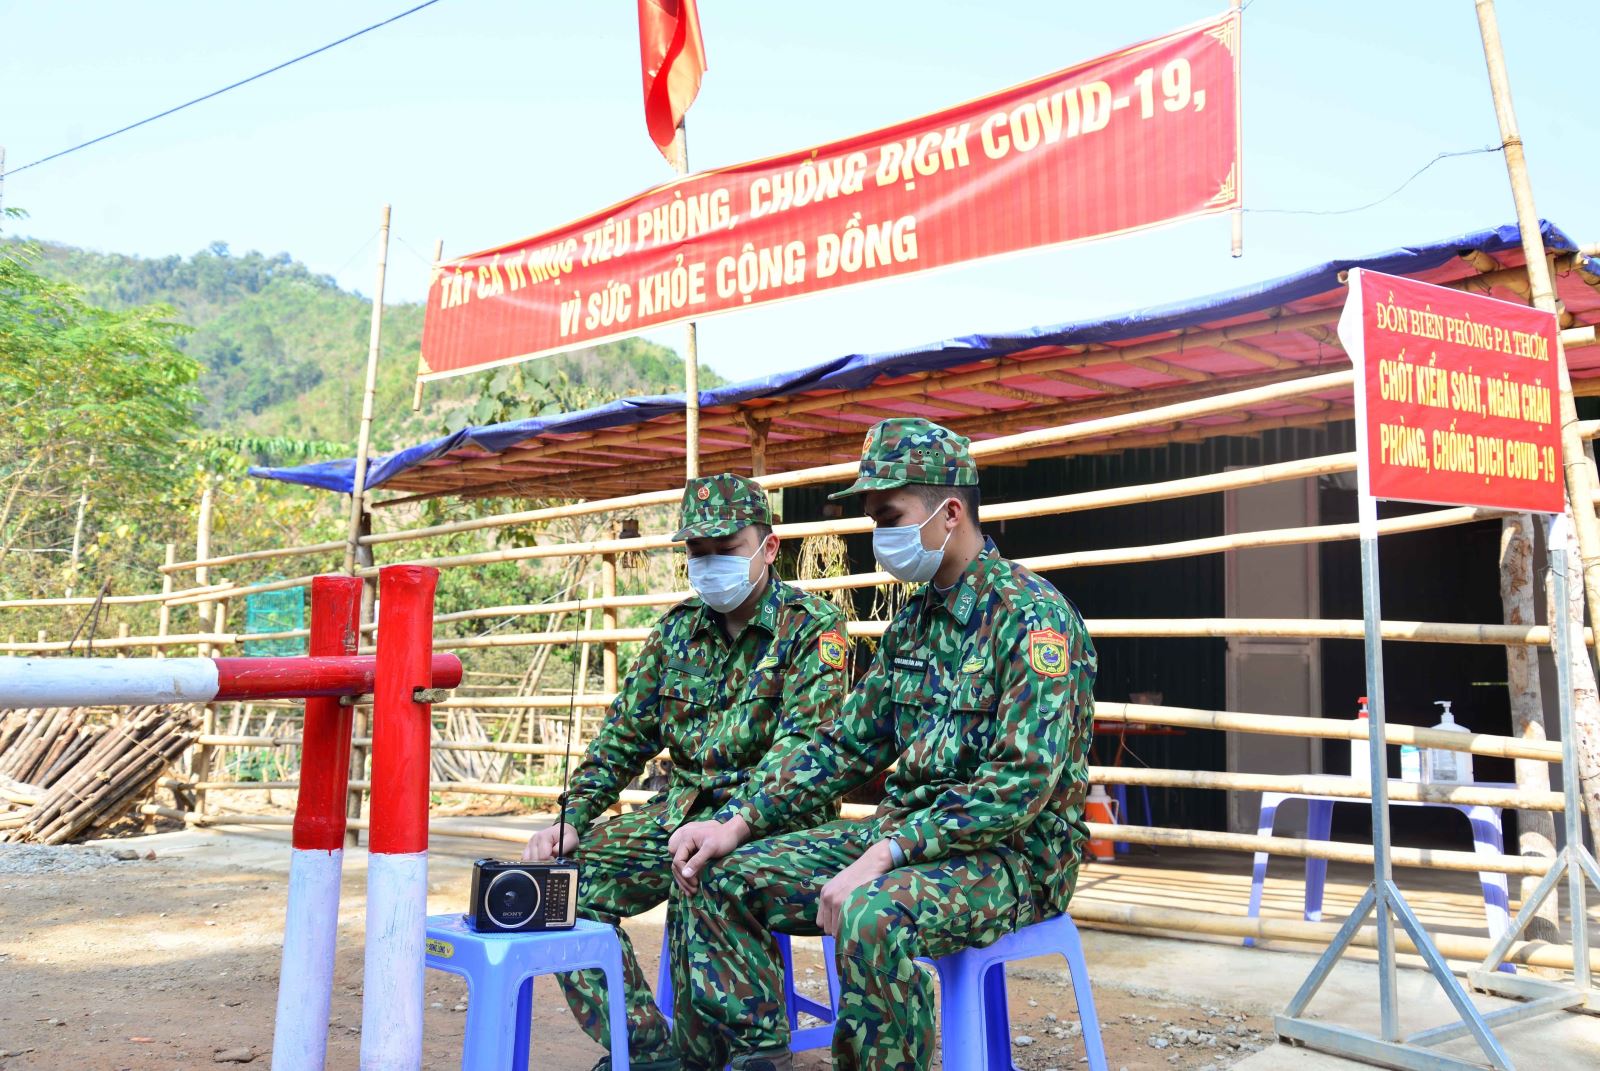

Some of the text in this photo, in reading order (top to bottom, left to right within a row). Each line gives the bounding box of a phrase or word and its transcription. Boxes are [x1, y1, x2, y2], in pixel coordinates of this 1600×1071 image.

[441, 262, 474, 310] TẤT
[504, 248, 527, 292] VÌ
[528, 238, 577, 286] MỤC
[581, 217, 631, 267] TIÊU
[635, 190, 739, 252] PHÒNG,
[750, 150, 868, 218] CHỐNG
[876, 123, 971, 192] DỊCH
[981, 57, 1206, 161] COVID-19,
[560, 211, 918, 337] VÌ SỨC KHỎE CỘNG ĐỒNG
[1376, 290, 1549, 362] ĐỒN BIÊN PHÒNG PA THƠM
[1379, 348, 1552, 431] CHỐT KIỂM SOÁT, NGĂN CHẶN
[1380, 415, 1556, 485] PHÒNG, CHỐNG DỊCH COVID-19
